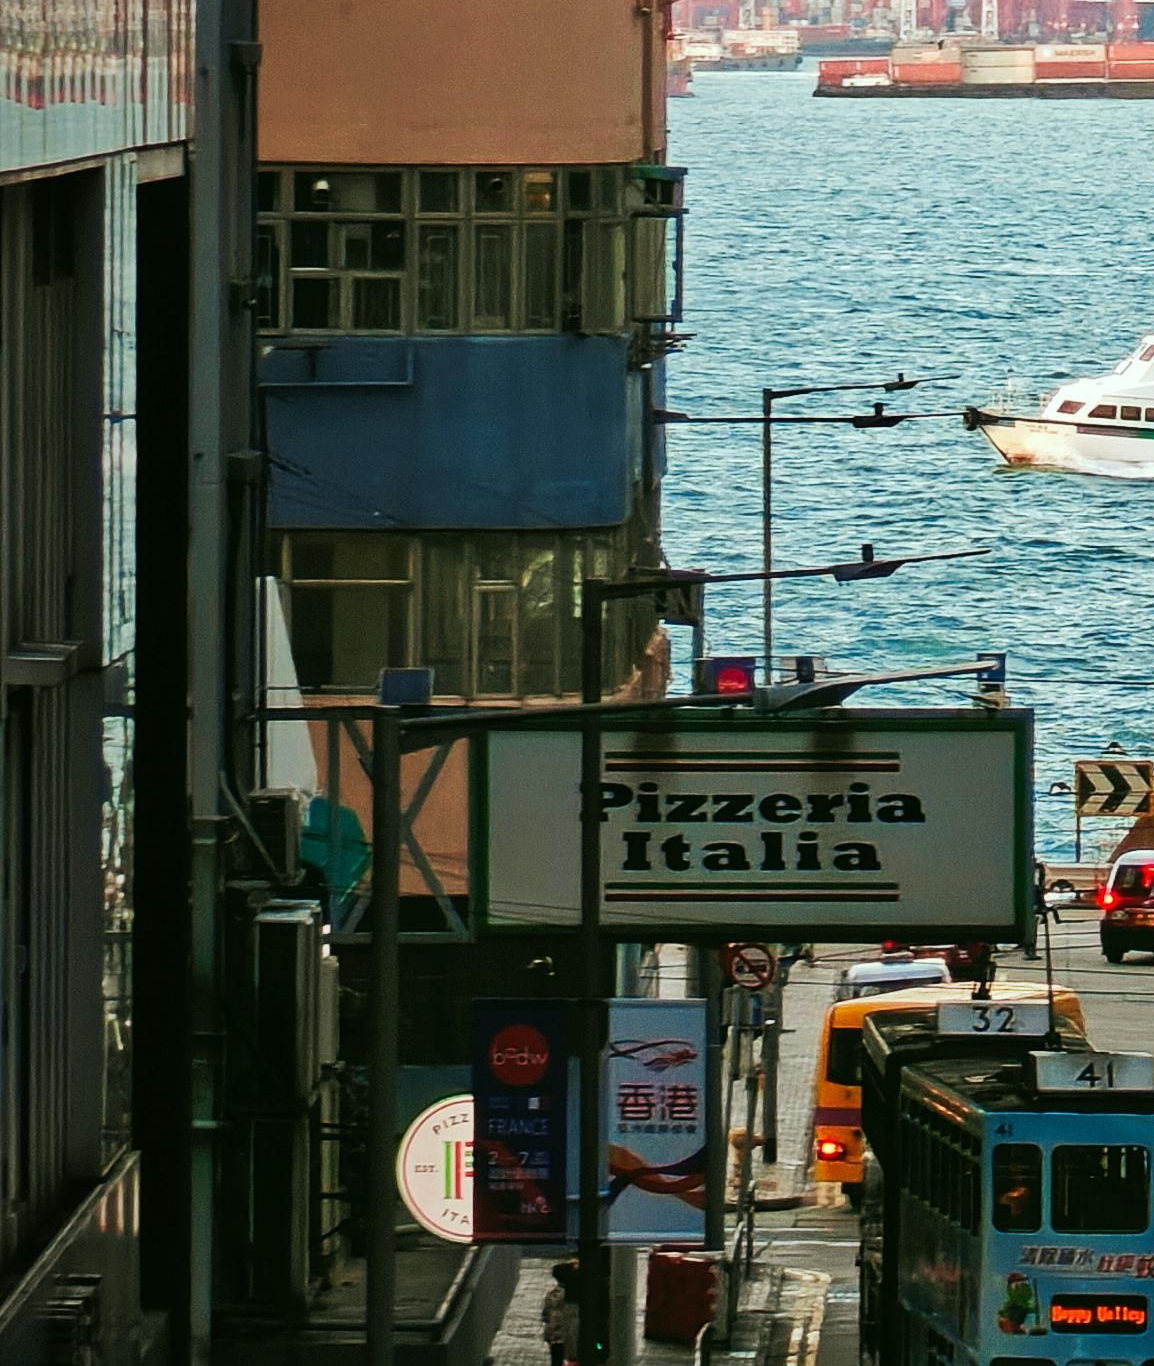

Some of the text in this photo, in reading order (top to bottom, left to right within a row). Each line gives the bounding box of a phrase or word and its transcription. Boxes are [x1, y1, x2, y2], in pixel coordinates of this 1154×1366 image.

[581, 782, 926, 823] Pizzeria
[622, 830, 882, 872] Italia
[972, 1006, 1015, 1033] 32
[492, 1045, 550, 1066] bodw
[1075, 1059, 1115, 1089] 41
[617, 1083, 698, 1121] 香港
[488, 1117, 551, 1135] FRANCE
[994, 1122, 1014, 1137] 41
[414, 1164, 439, 1173] EST.
